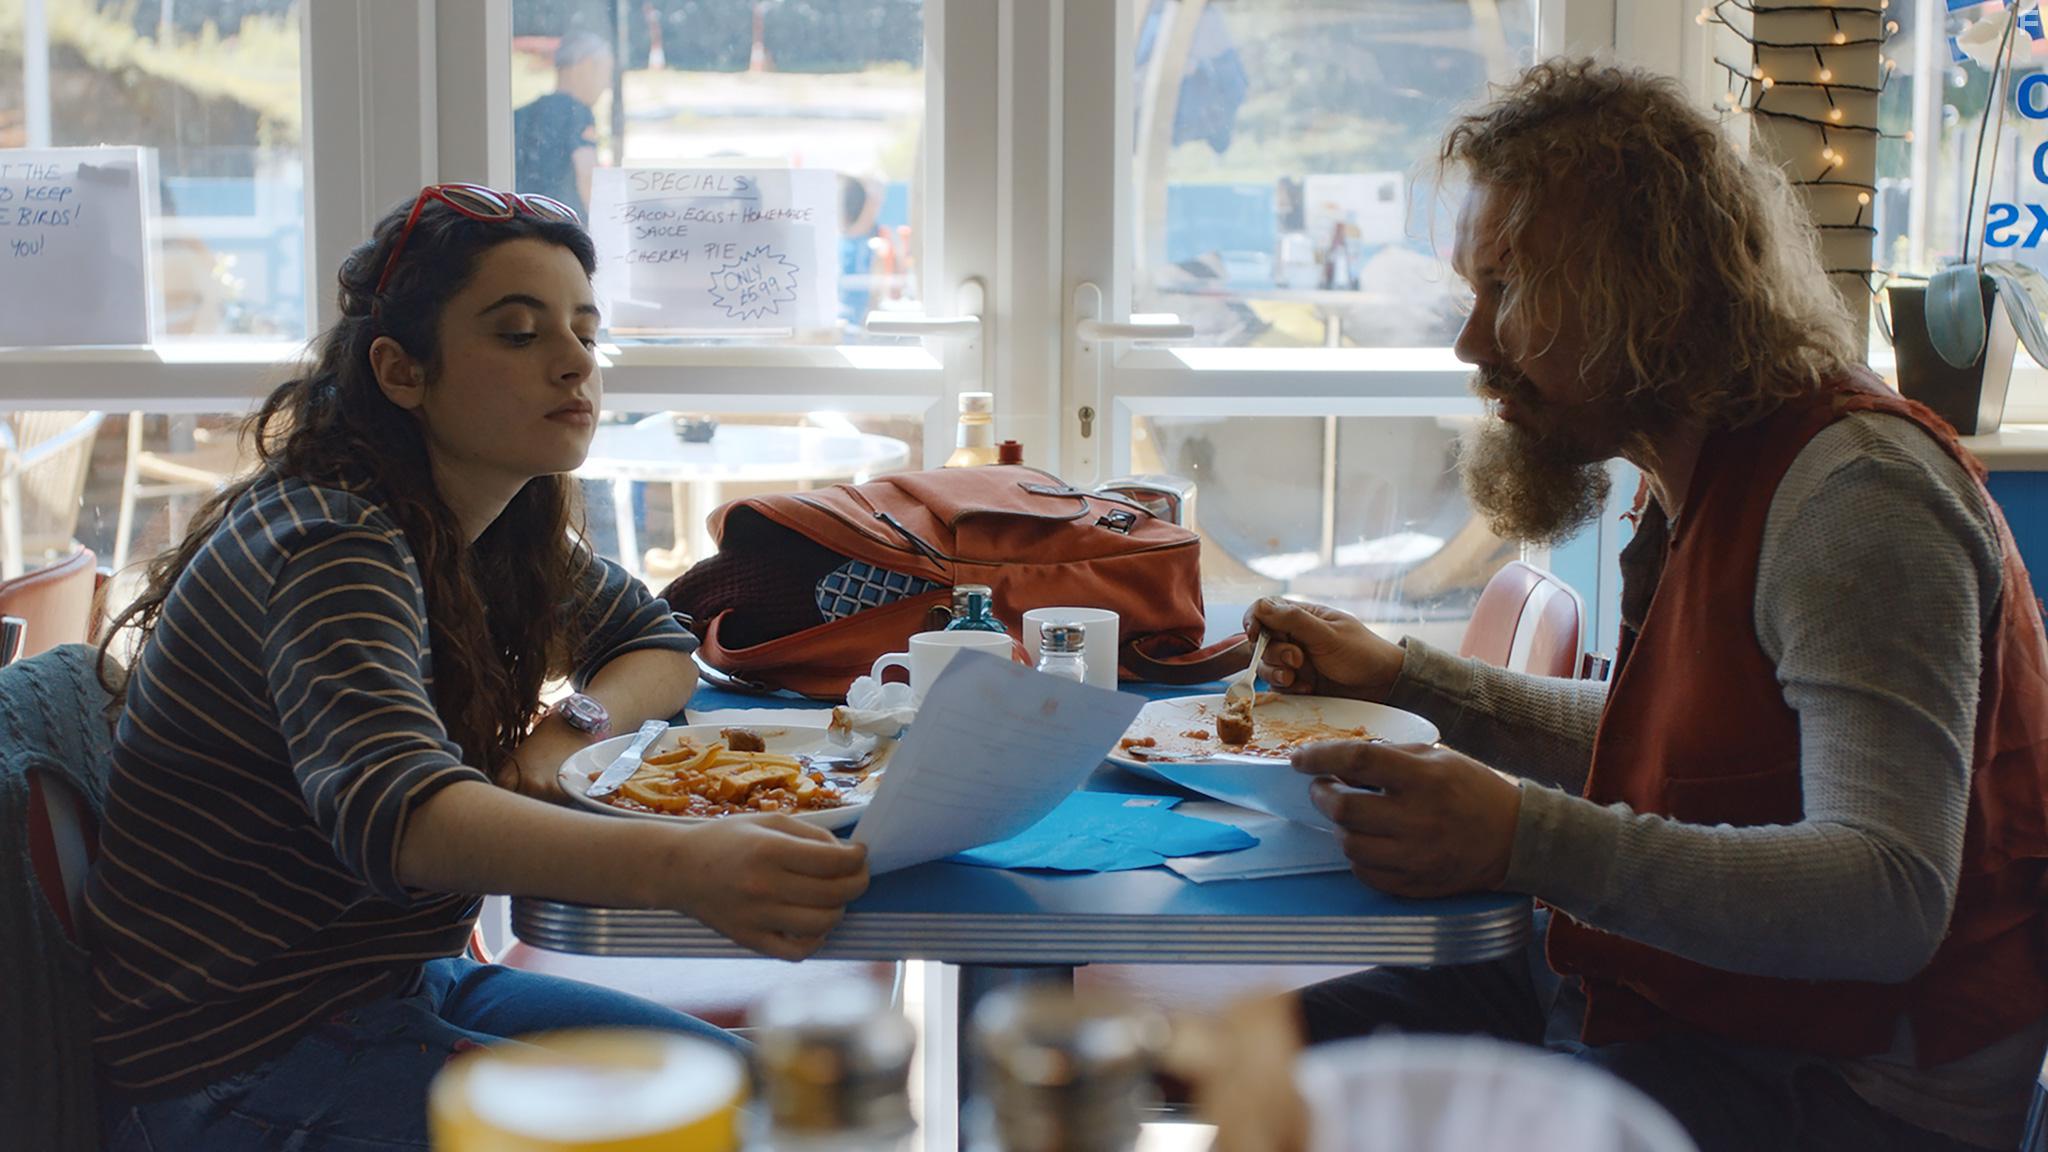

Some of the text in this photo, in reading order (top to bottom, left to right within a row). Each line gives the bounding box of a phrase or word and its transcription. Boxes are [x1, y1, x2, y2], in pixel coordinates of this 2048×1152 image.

[18, 163, 62, 180] THE
[629, 171, 750, 192] SPECIALS
[25, 186, 73, 202] KEEP
[17, 203, 81, 226] BIRDS!
[682, 207, 725, 224] EGGS
[635, 224, 689, 240] SAUCE
[10, 233, 45, 258] YOU!
[624, 248, 689, 265] CHERRY
[703, 242, 737, 260] PIE
[723, 263, 763, 292] ONLY
